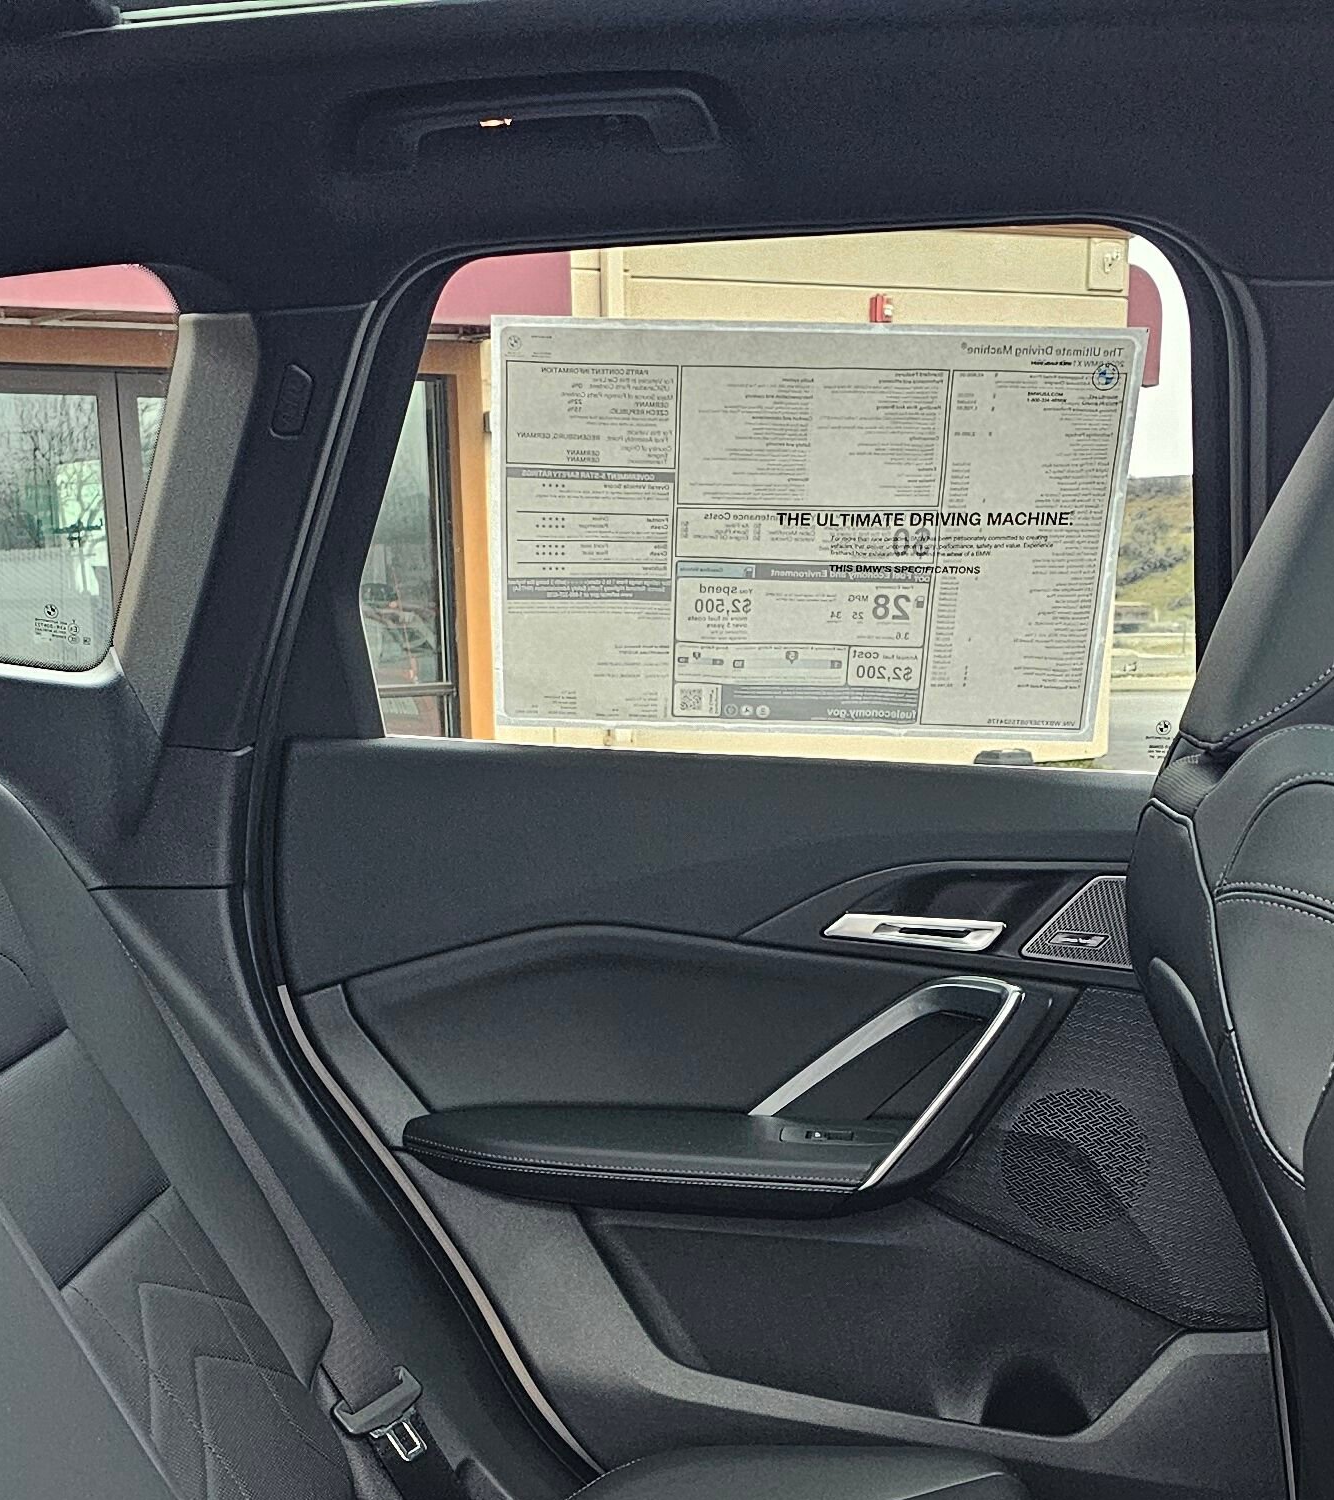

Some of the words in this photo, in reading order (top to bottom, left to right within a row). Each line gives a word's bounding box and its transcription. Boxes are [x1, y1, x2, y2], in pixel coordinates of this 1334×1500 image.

[776, 512, 811, 526] THE
[816, 512, 904, 527] ULTIMATE
[908, 512, 981, 527] DRIVING
[985, 511, 1074, 526] MACHINE.
[829, 564, 854, 572] THIS
[855, 564, 892, 573] BMW'S
[894, 564, 979, 575] SPECIFICATIONS
